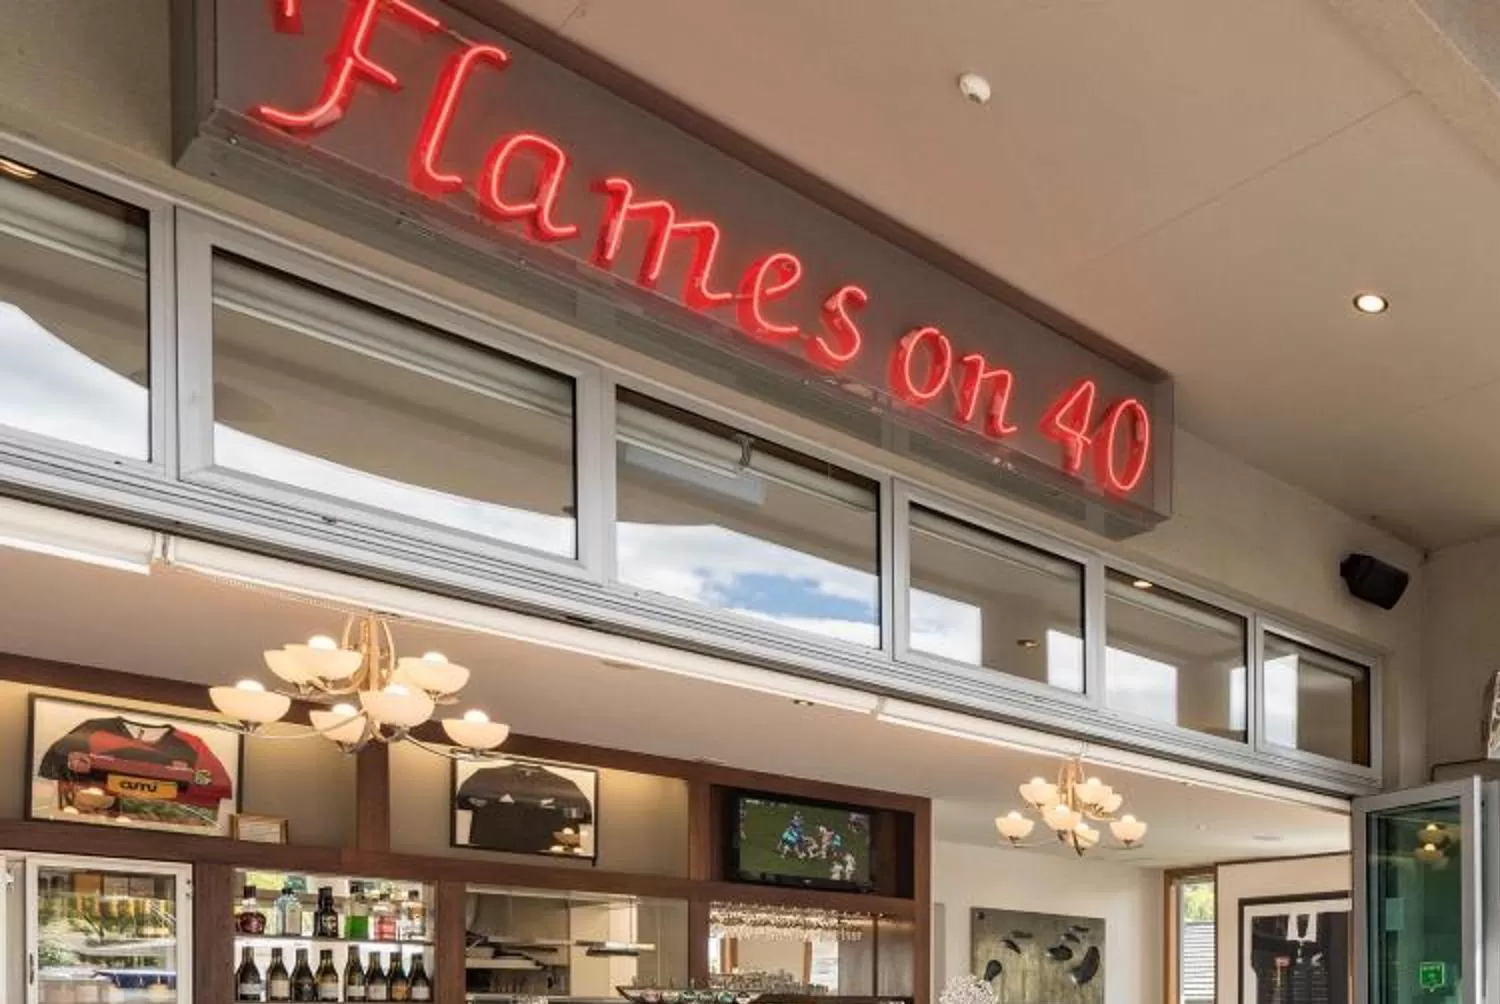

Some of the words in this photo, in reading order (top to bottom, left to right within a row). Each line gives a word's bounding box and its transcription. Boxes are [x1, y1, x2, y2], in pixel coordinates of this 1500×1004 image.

[248, 0, 869, 370] Flames
[891, 326, 1018, 437] on
[1040, 379, 1150, 498] 40
